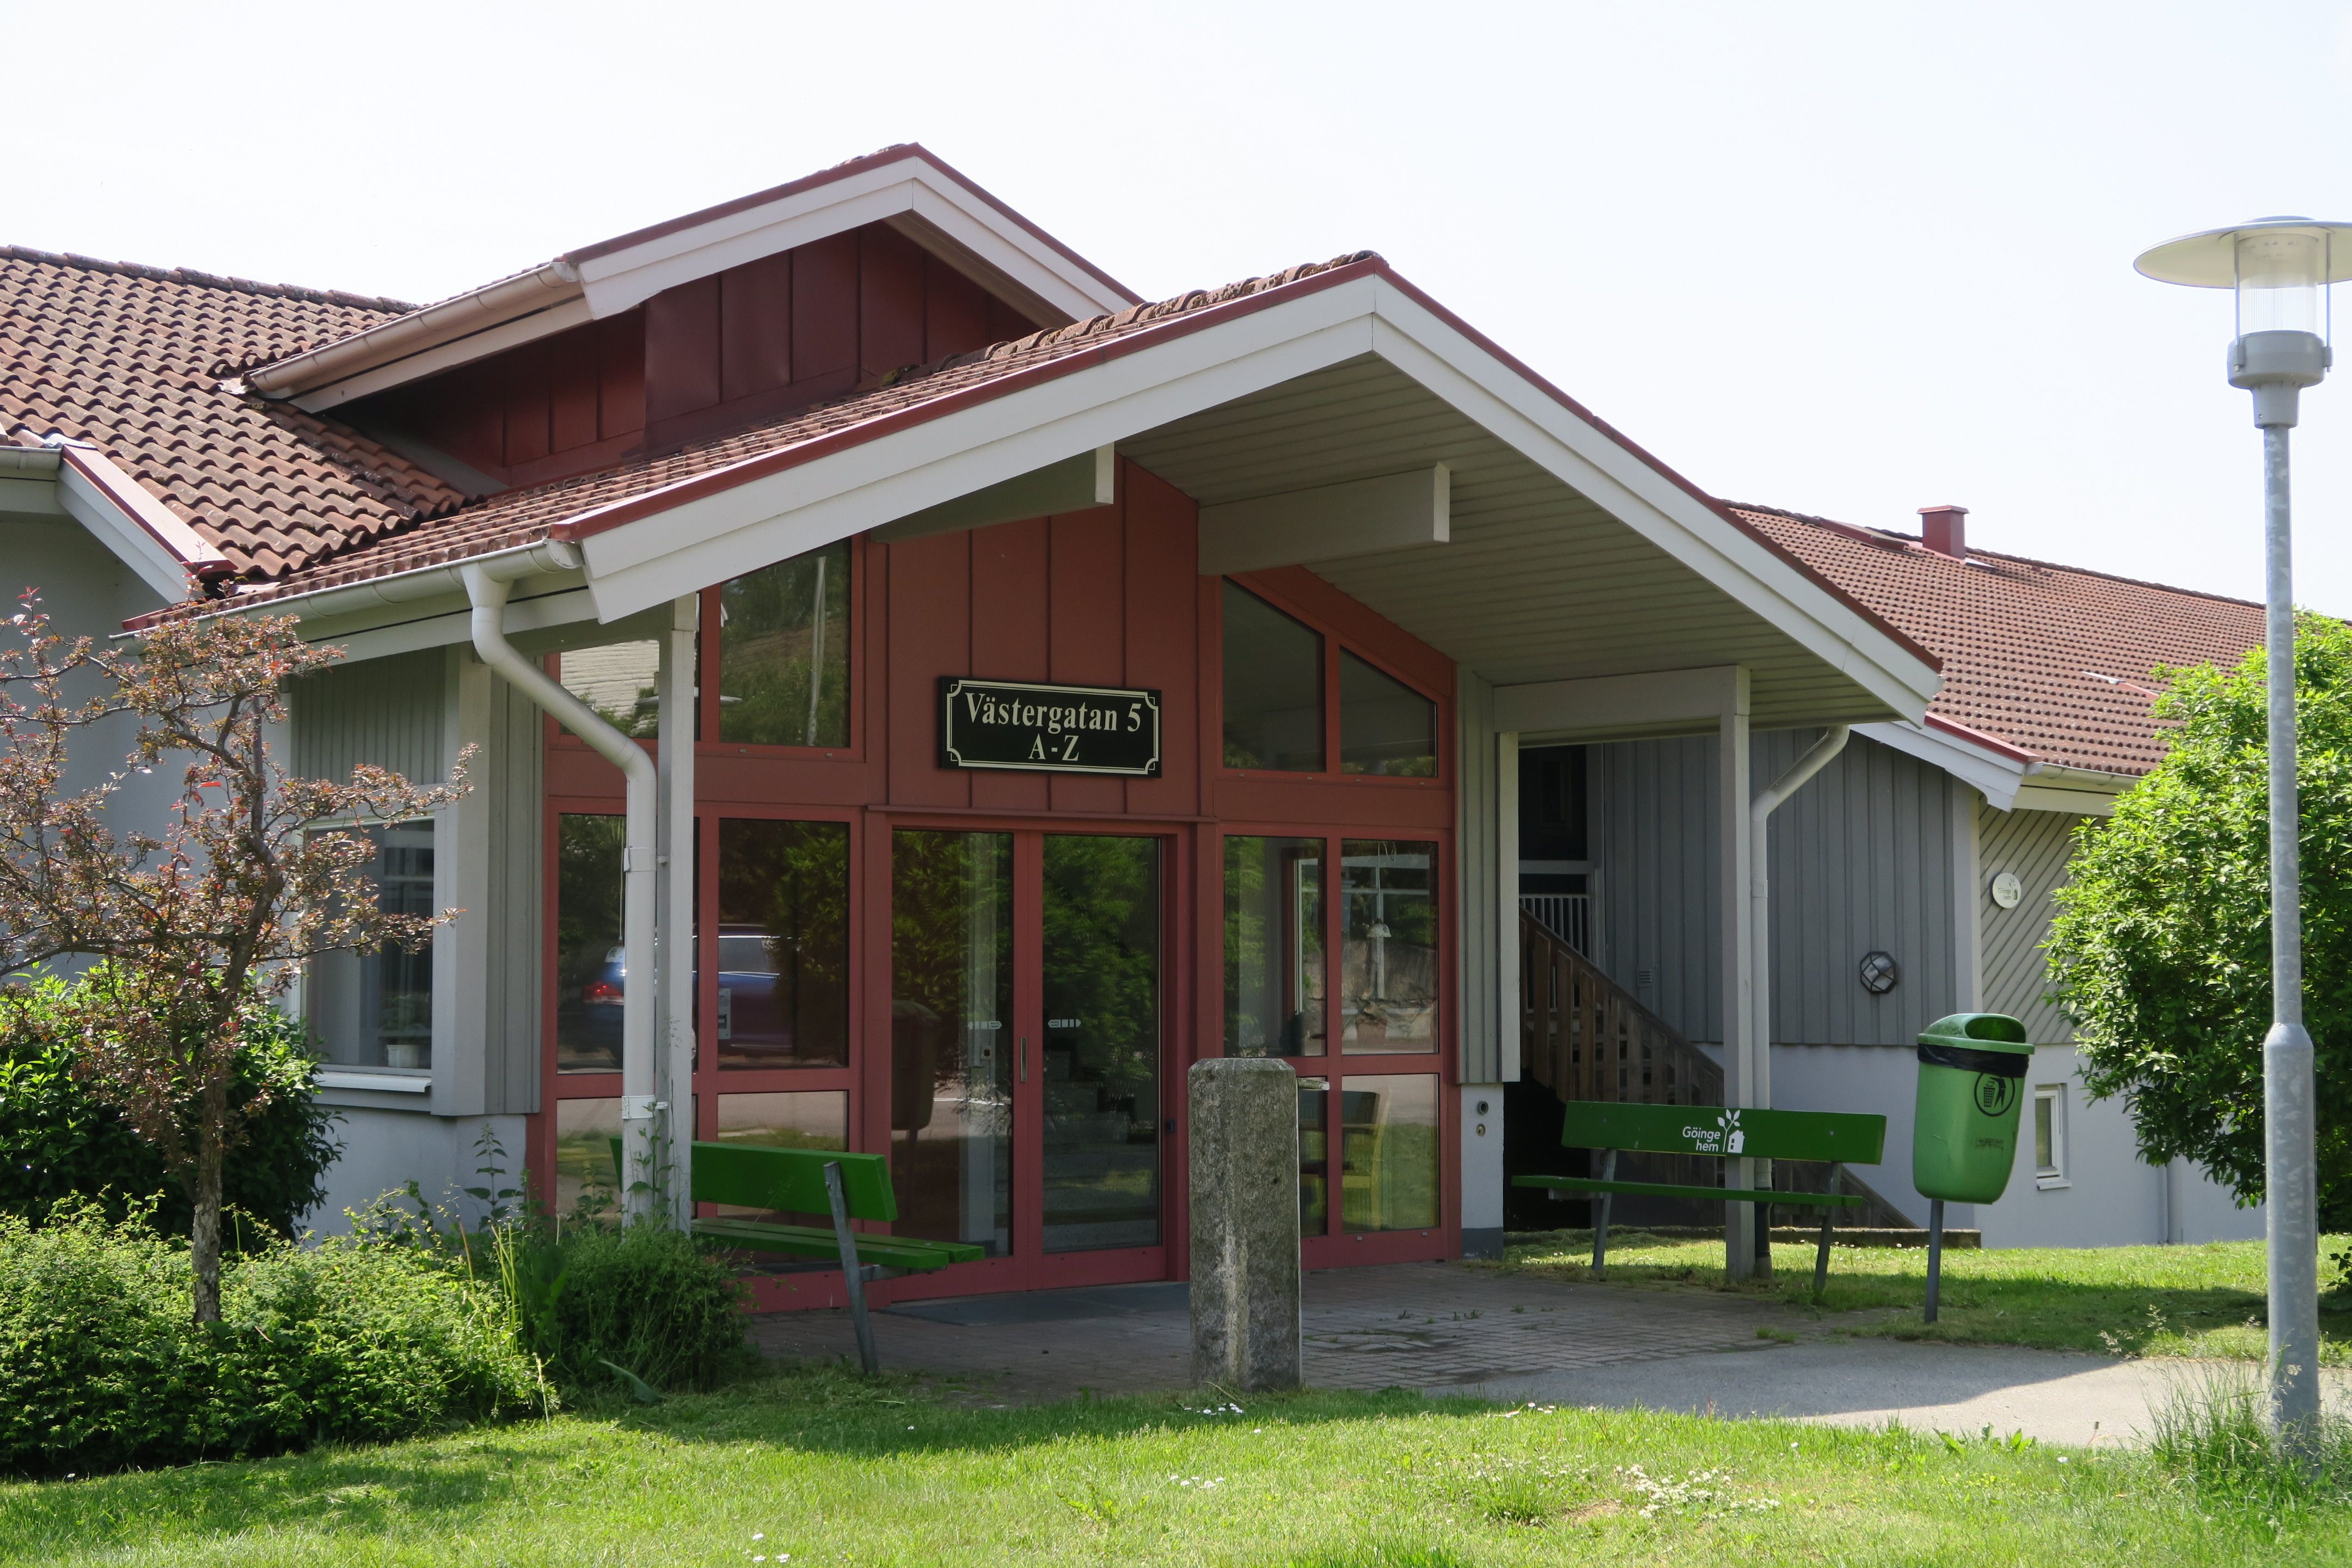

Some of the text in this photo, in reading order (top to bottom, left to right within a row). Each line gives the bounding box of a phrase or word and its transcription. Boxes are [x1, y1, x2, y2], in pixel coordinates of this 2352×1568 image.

[965, 693, 1142, 734] Västergatan 5
[1682, 1126, 1720, 1142] Göinge
[1695, 1139, 1719, 1152] hem
